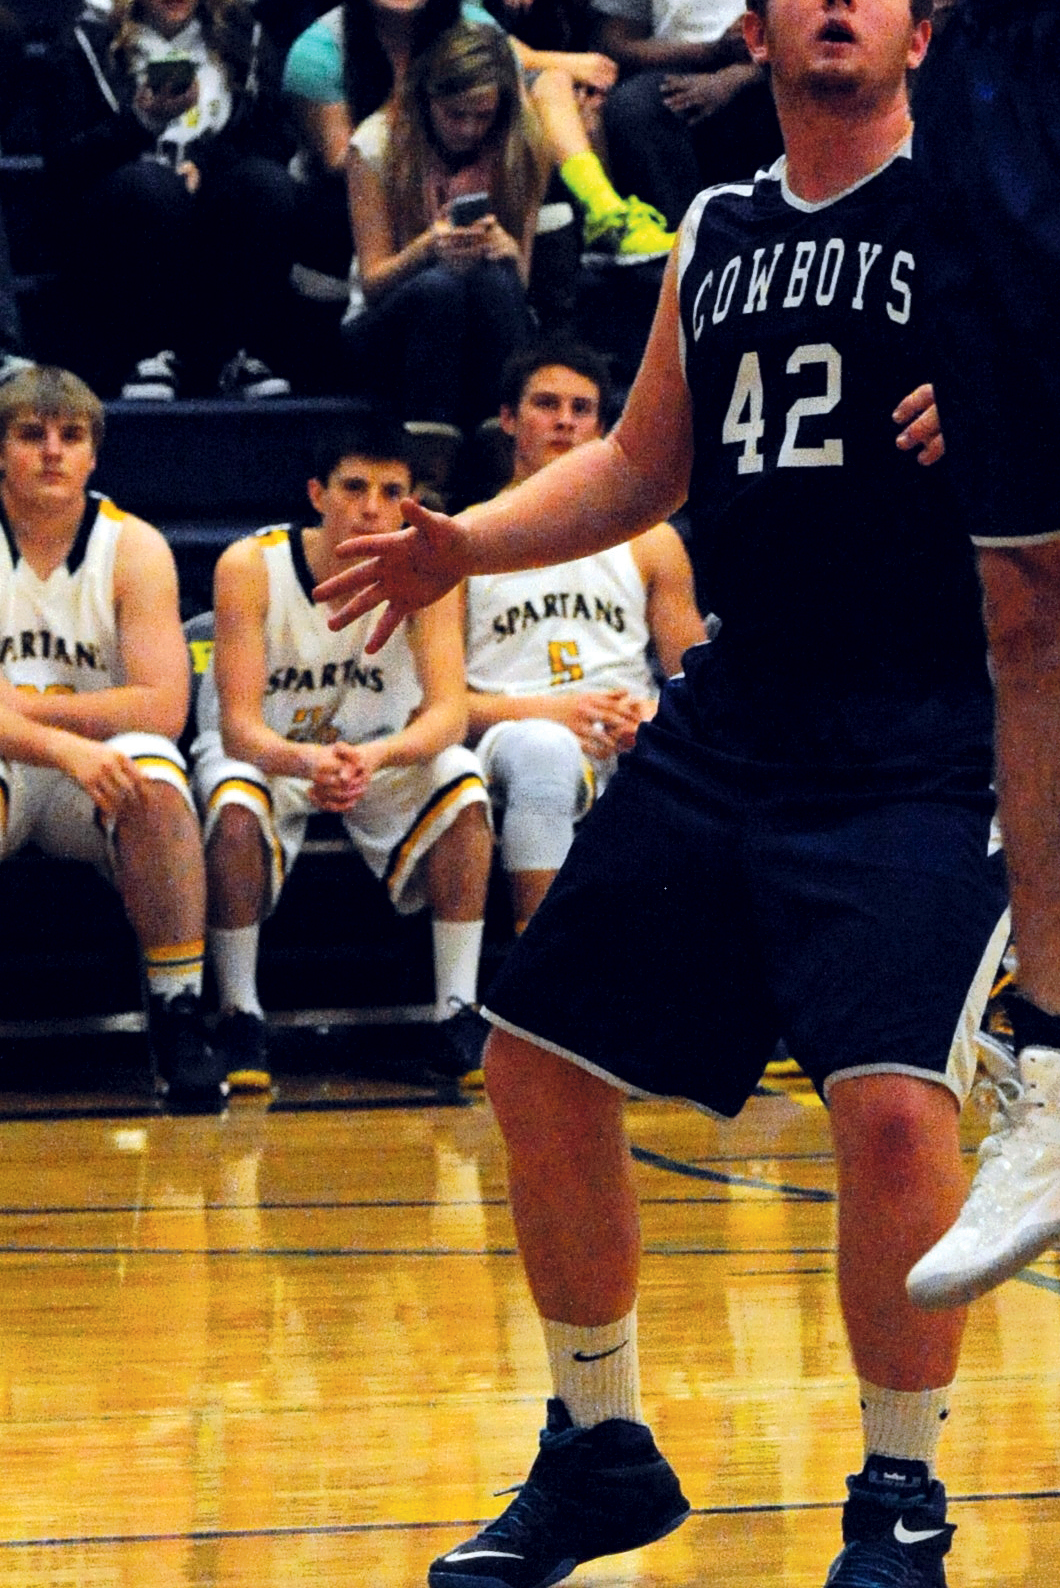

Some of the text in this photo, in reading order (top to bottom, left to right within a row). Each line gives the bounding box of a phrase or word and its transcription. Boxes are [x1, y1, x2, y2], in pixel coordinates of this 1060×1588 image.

[692, 237, 916, 342] COWBOYS
[722, 342, 844, 475] 42
[492, 592, 626, 642] SPARTANS
[548, 639, 585, 687] 5
